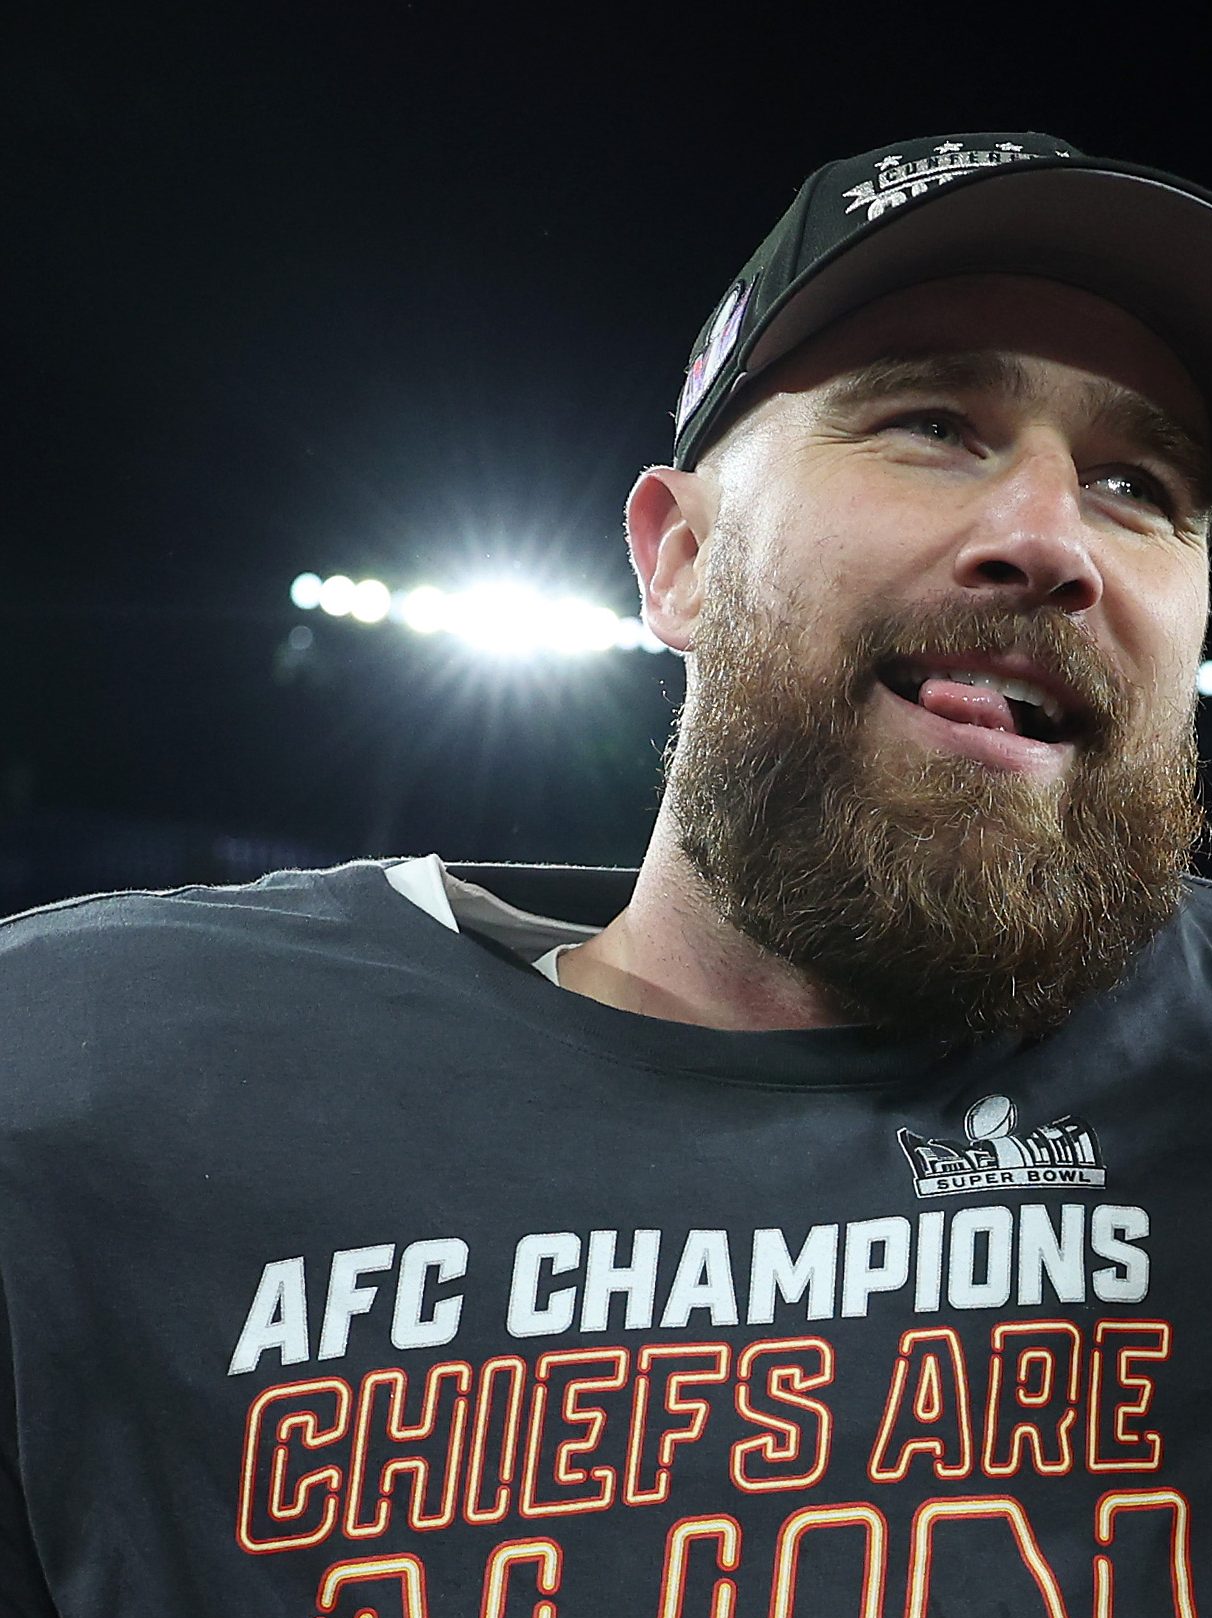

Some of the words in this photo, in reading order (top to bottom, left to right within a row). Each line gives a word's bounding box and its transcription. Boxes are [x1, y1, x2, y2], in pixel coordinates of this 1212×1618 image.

[936, 1172, 1014, 1190] SUPER
[1028, 1168, 1092, 1184] BOWL
[228, 1238, 469, 1376] AFC
[507, 1204, 1150, 1338] CHAMPIONS
[236, 1335, 835, 1555] CHIEFS
[867, 1318, 1172, 1483] ARE
